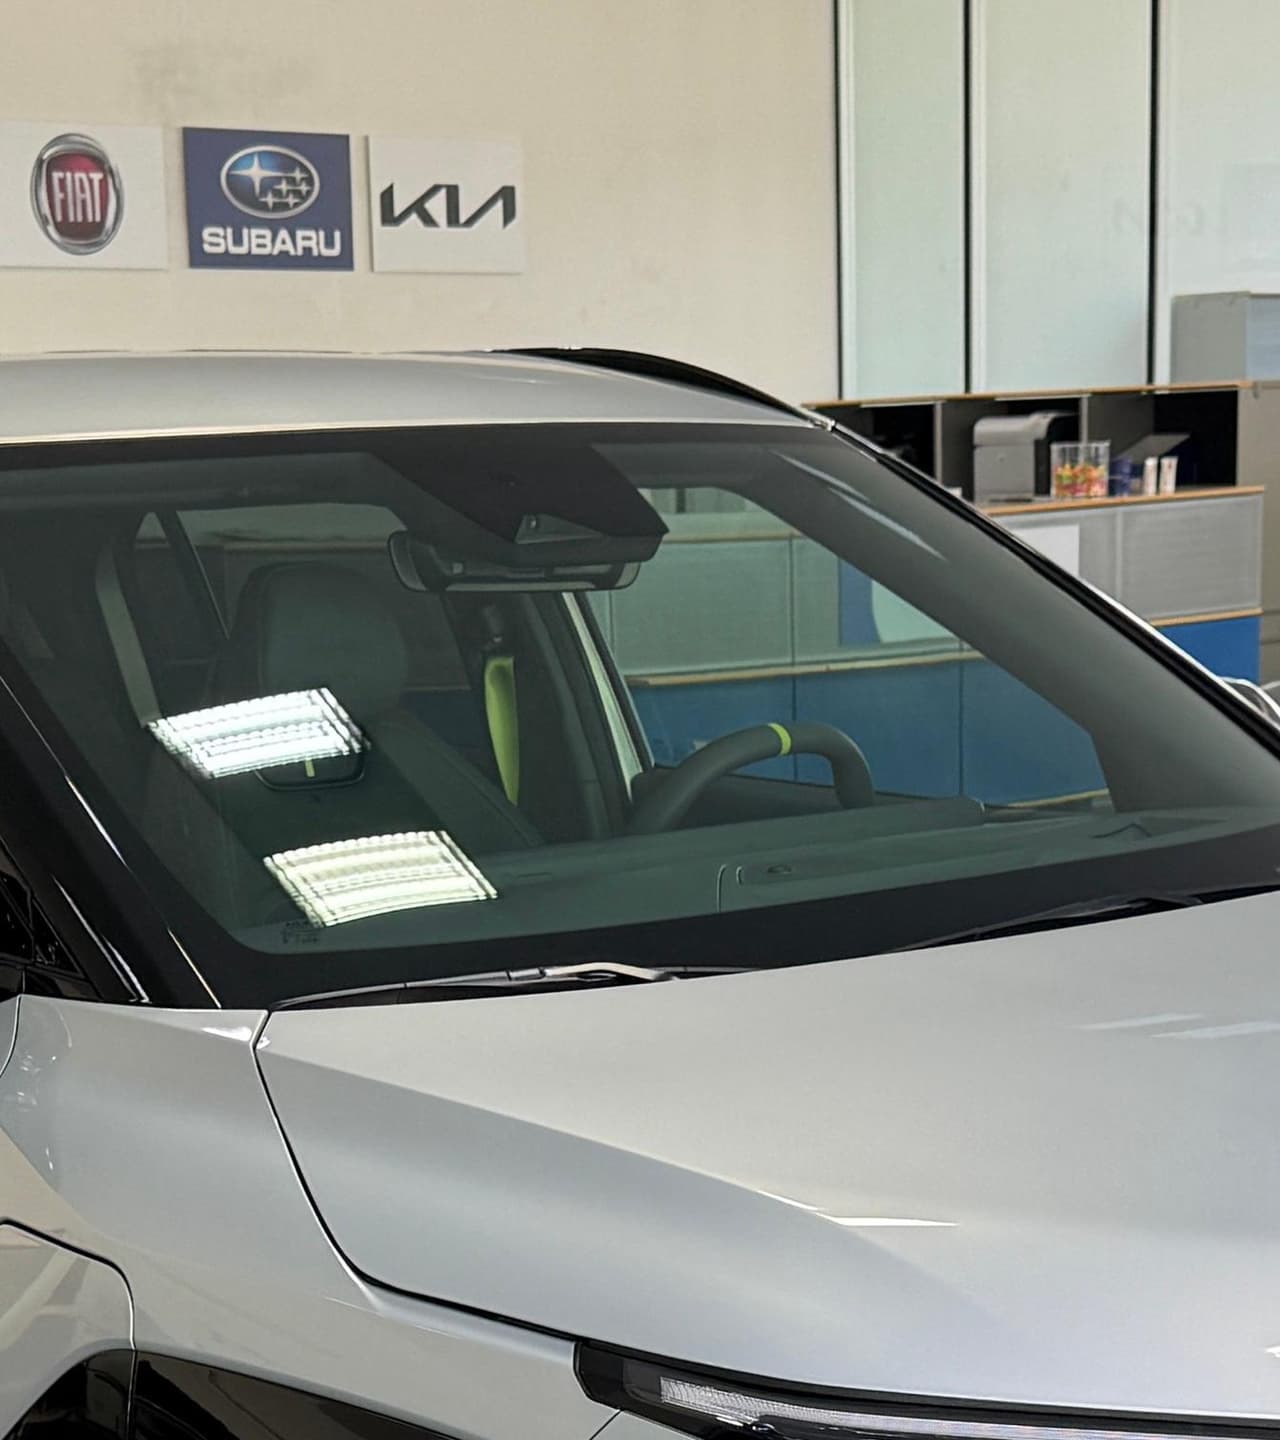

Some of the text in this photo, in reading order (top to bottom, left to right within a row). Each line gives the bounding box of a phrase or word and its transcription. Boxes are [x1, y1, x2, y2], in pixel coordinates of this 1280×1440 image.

[51, 171, 104, 223] FIAT
[379, 182, 516, 229] KIA
[201, 226, 342, 257] SUBARU
